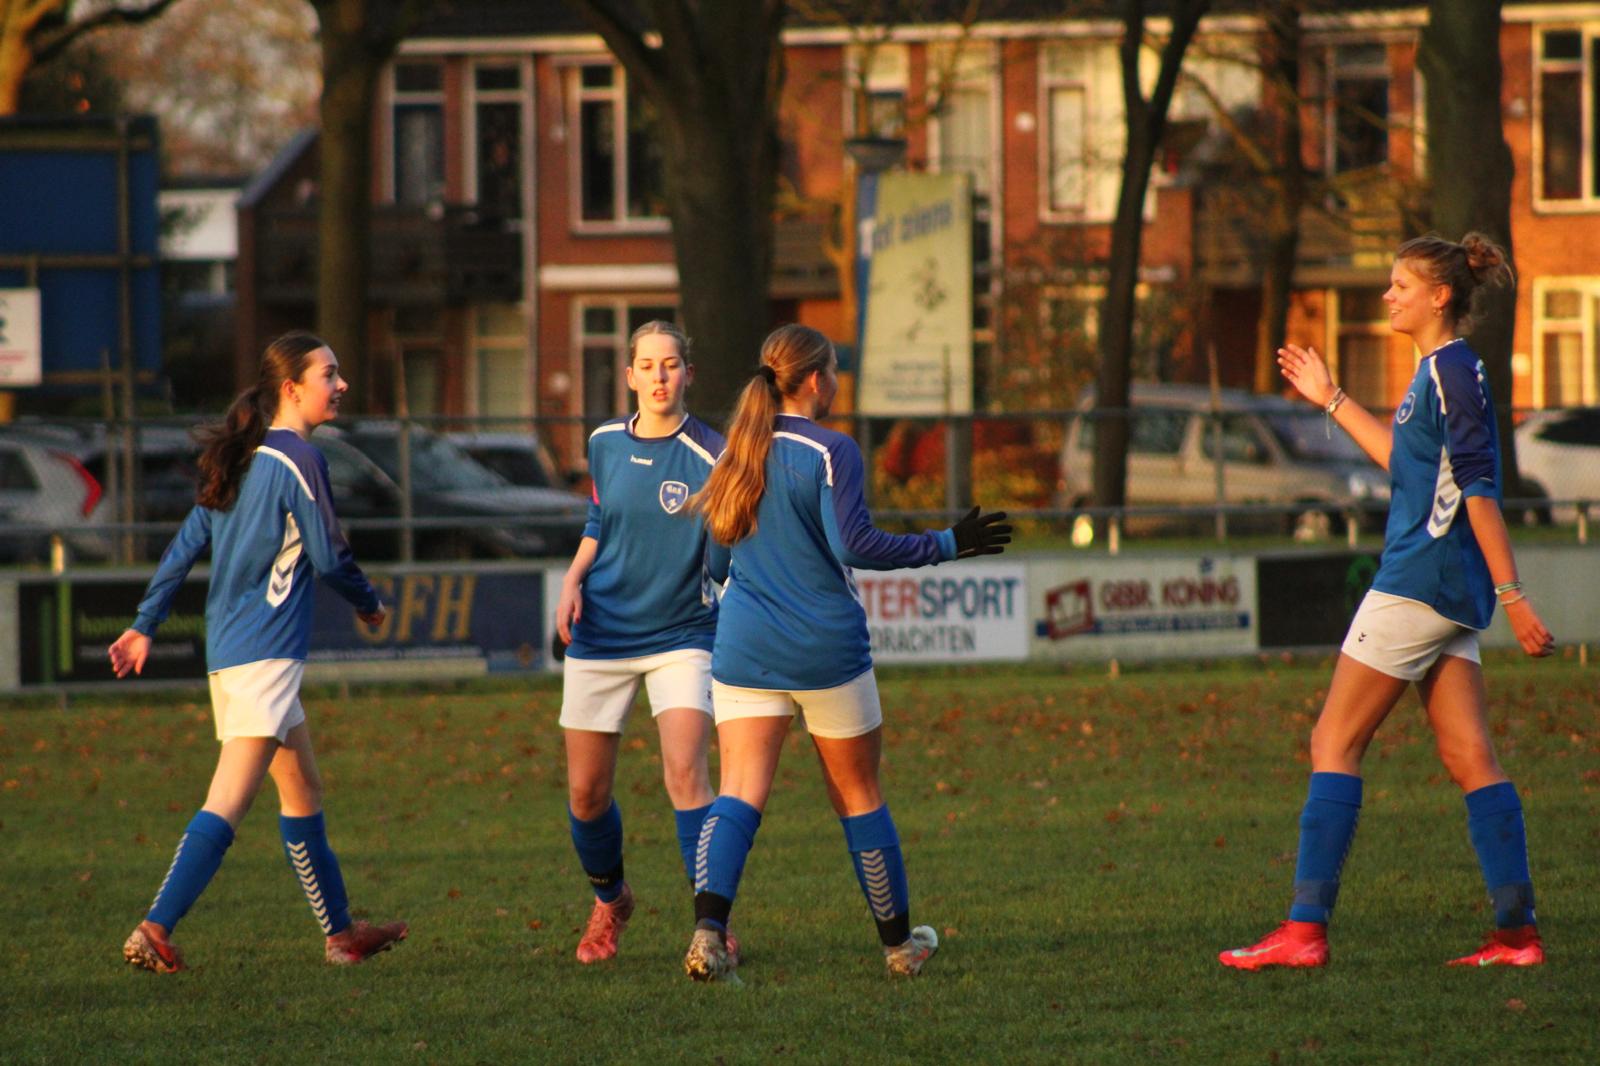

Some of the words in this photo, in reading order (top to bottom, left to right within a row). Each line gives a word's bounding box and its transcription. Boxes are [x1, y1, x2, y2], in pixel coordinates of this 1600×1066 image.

[355, 575, 477, 643] GFH
[858, 577, 1019, 621] TERSPORT
[871, 626, 977, 653] DRACHTEN
